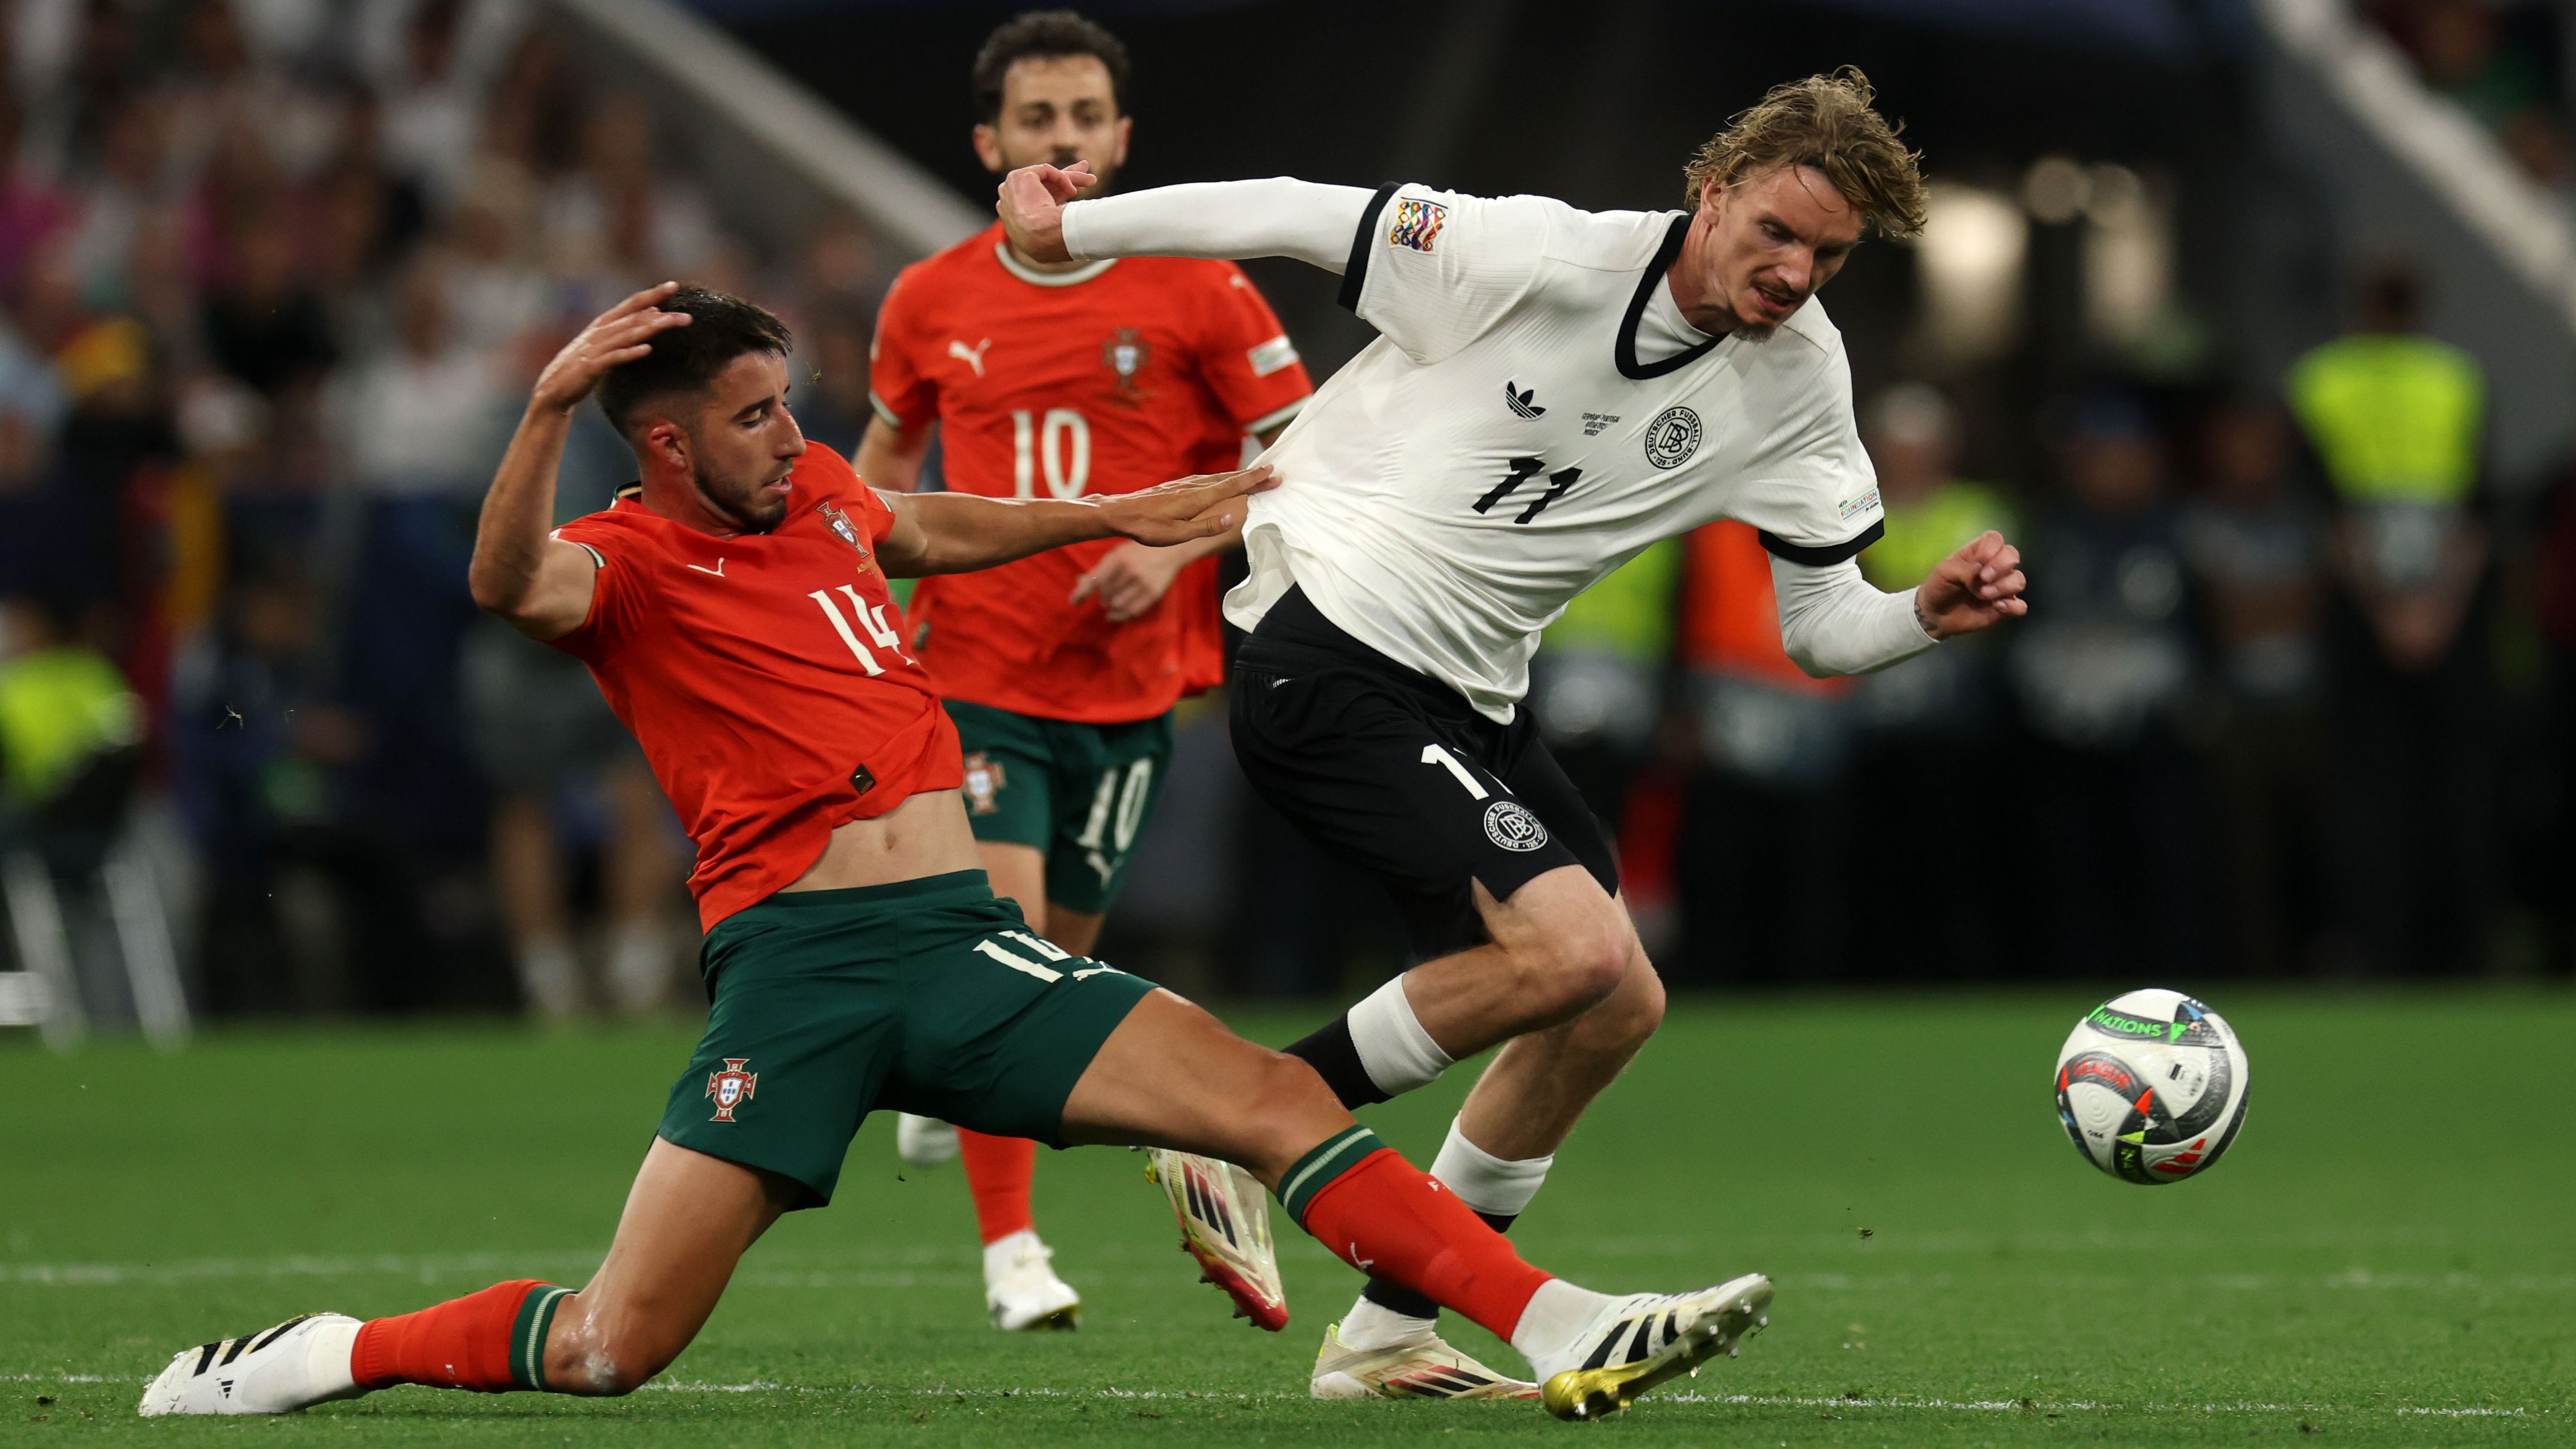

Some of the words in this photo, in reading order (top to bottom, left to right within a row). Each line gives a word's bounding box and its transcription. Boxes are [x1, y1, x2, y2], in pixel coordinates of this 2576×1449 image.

[1648, 411, 1676, 455] DEUTSCHER
[1013, 408, 1091, 499] 10
[1655, 457, 1667, 466] 125
[1472, 458, 1582, 524] 11
[1841, 491, 1877, 518] FOUNDATION
[807, 584, 915, 677] 14
[1077, 757, 1153, 853] 10
[1488, 811, 1519, 848] DEUTSCHER
[2095, 1011, 2162, 1037] NATIONS
[2073, 1058, 2132, 1090] LEAGUE
